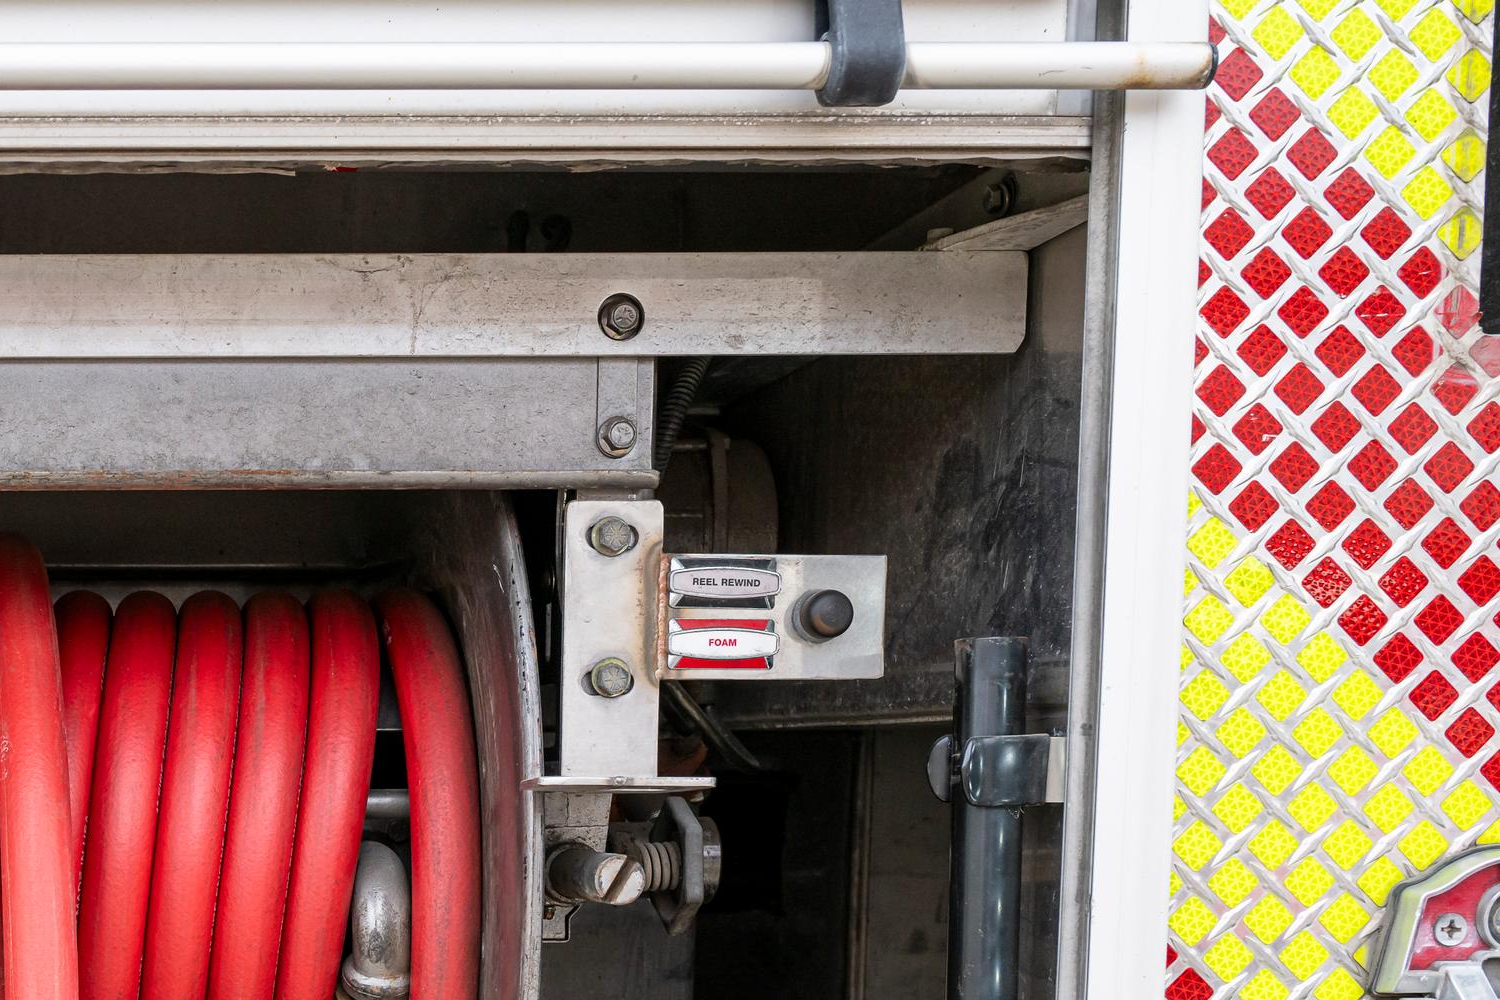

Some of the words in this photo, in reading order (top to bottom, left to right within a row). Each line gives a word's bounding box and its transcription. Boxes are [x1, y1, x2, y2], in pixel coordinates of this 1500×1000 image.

[692, 577, 718, 586] REEL
[721, 578, 761, 587] REWIND
[708, 638, 737, 646] FOAM
